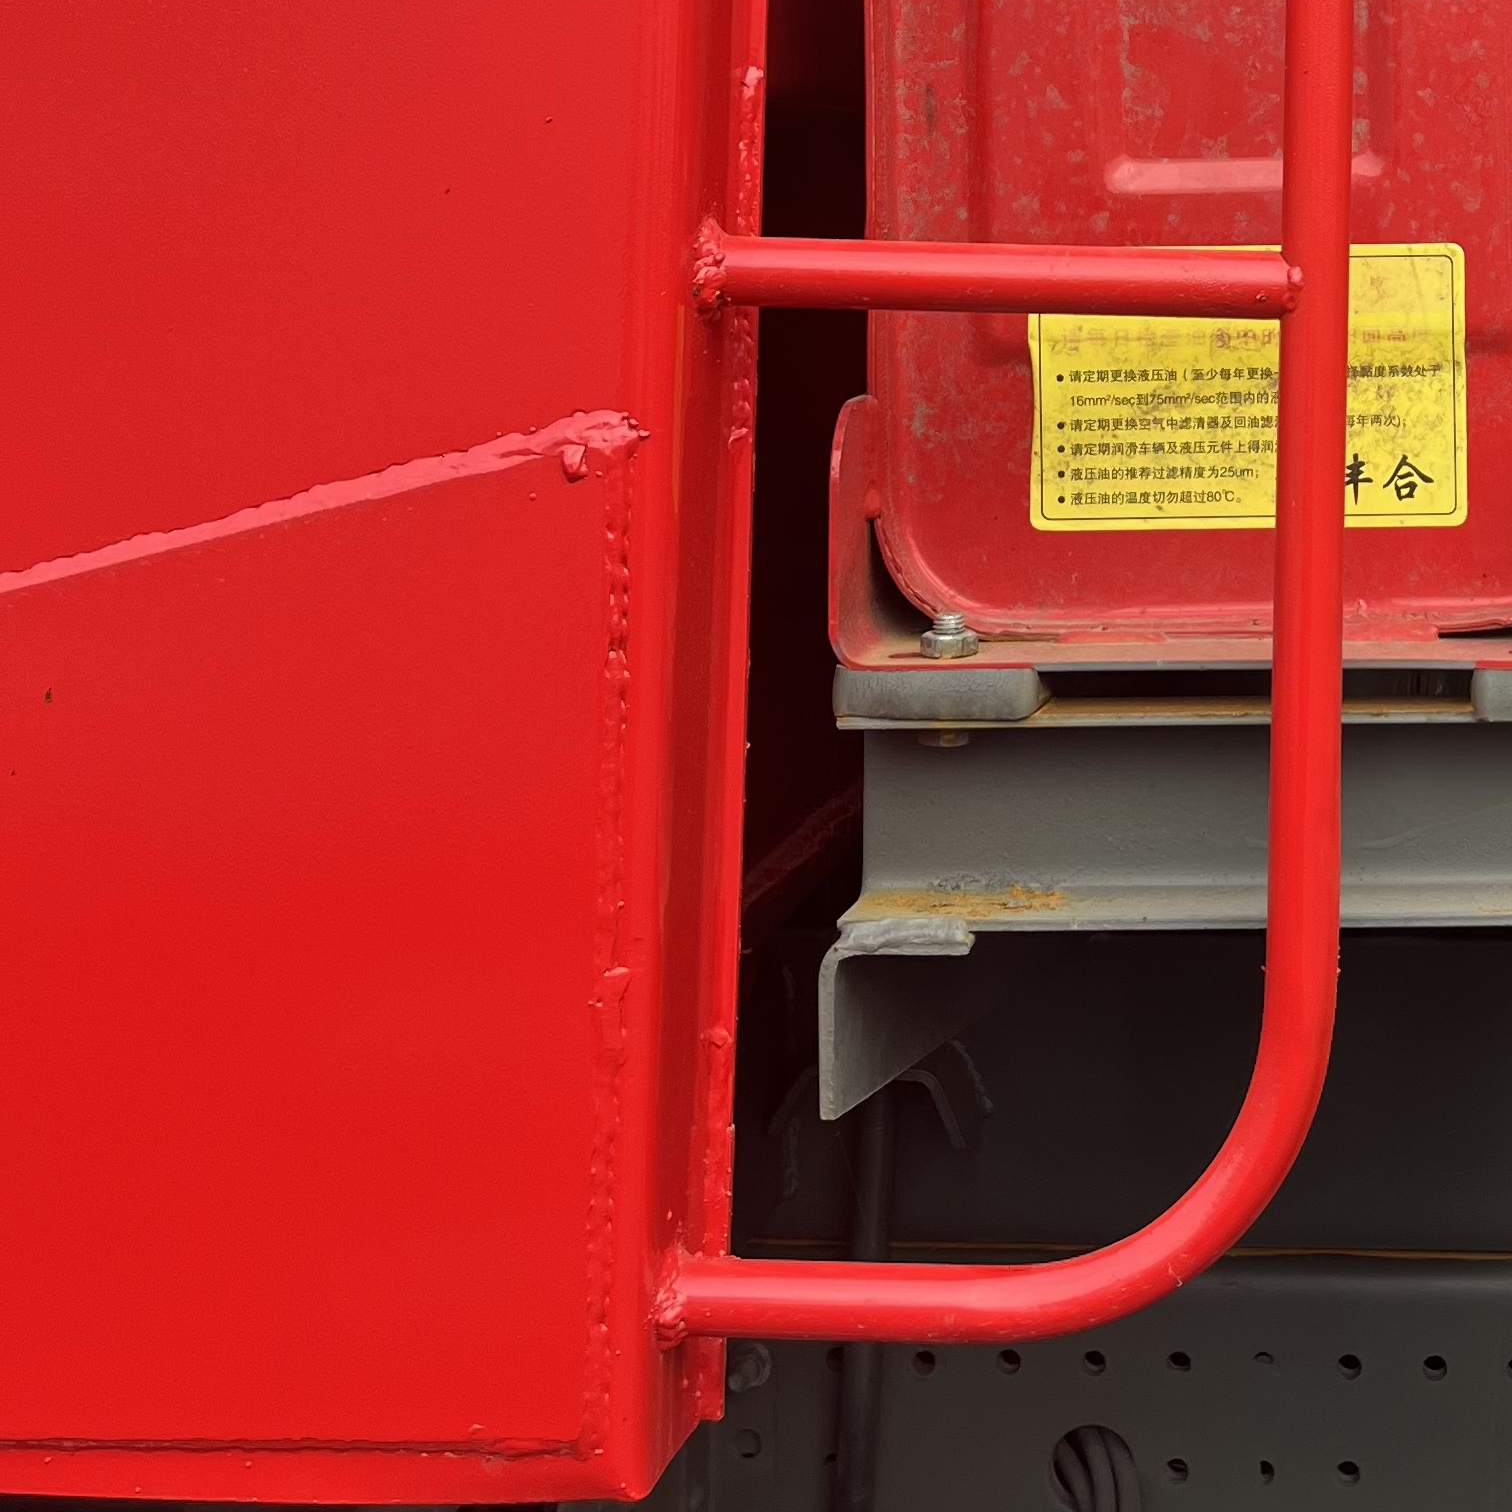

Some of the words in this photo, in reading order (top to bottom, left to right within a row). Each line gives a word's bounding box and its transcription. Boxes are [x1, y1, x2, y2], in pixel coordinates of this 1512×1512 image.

[1070, 440, 1278, 456] 请定期润滑车辆及液压元件上得润
